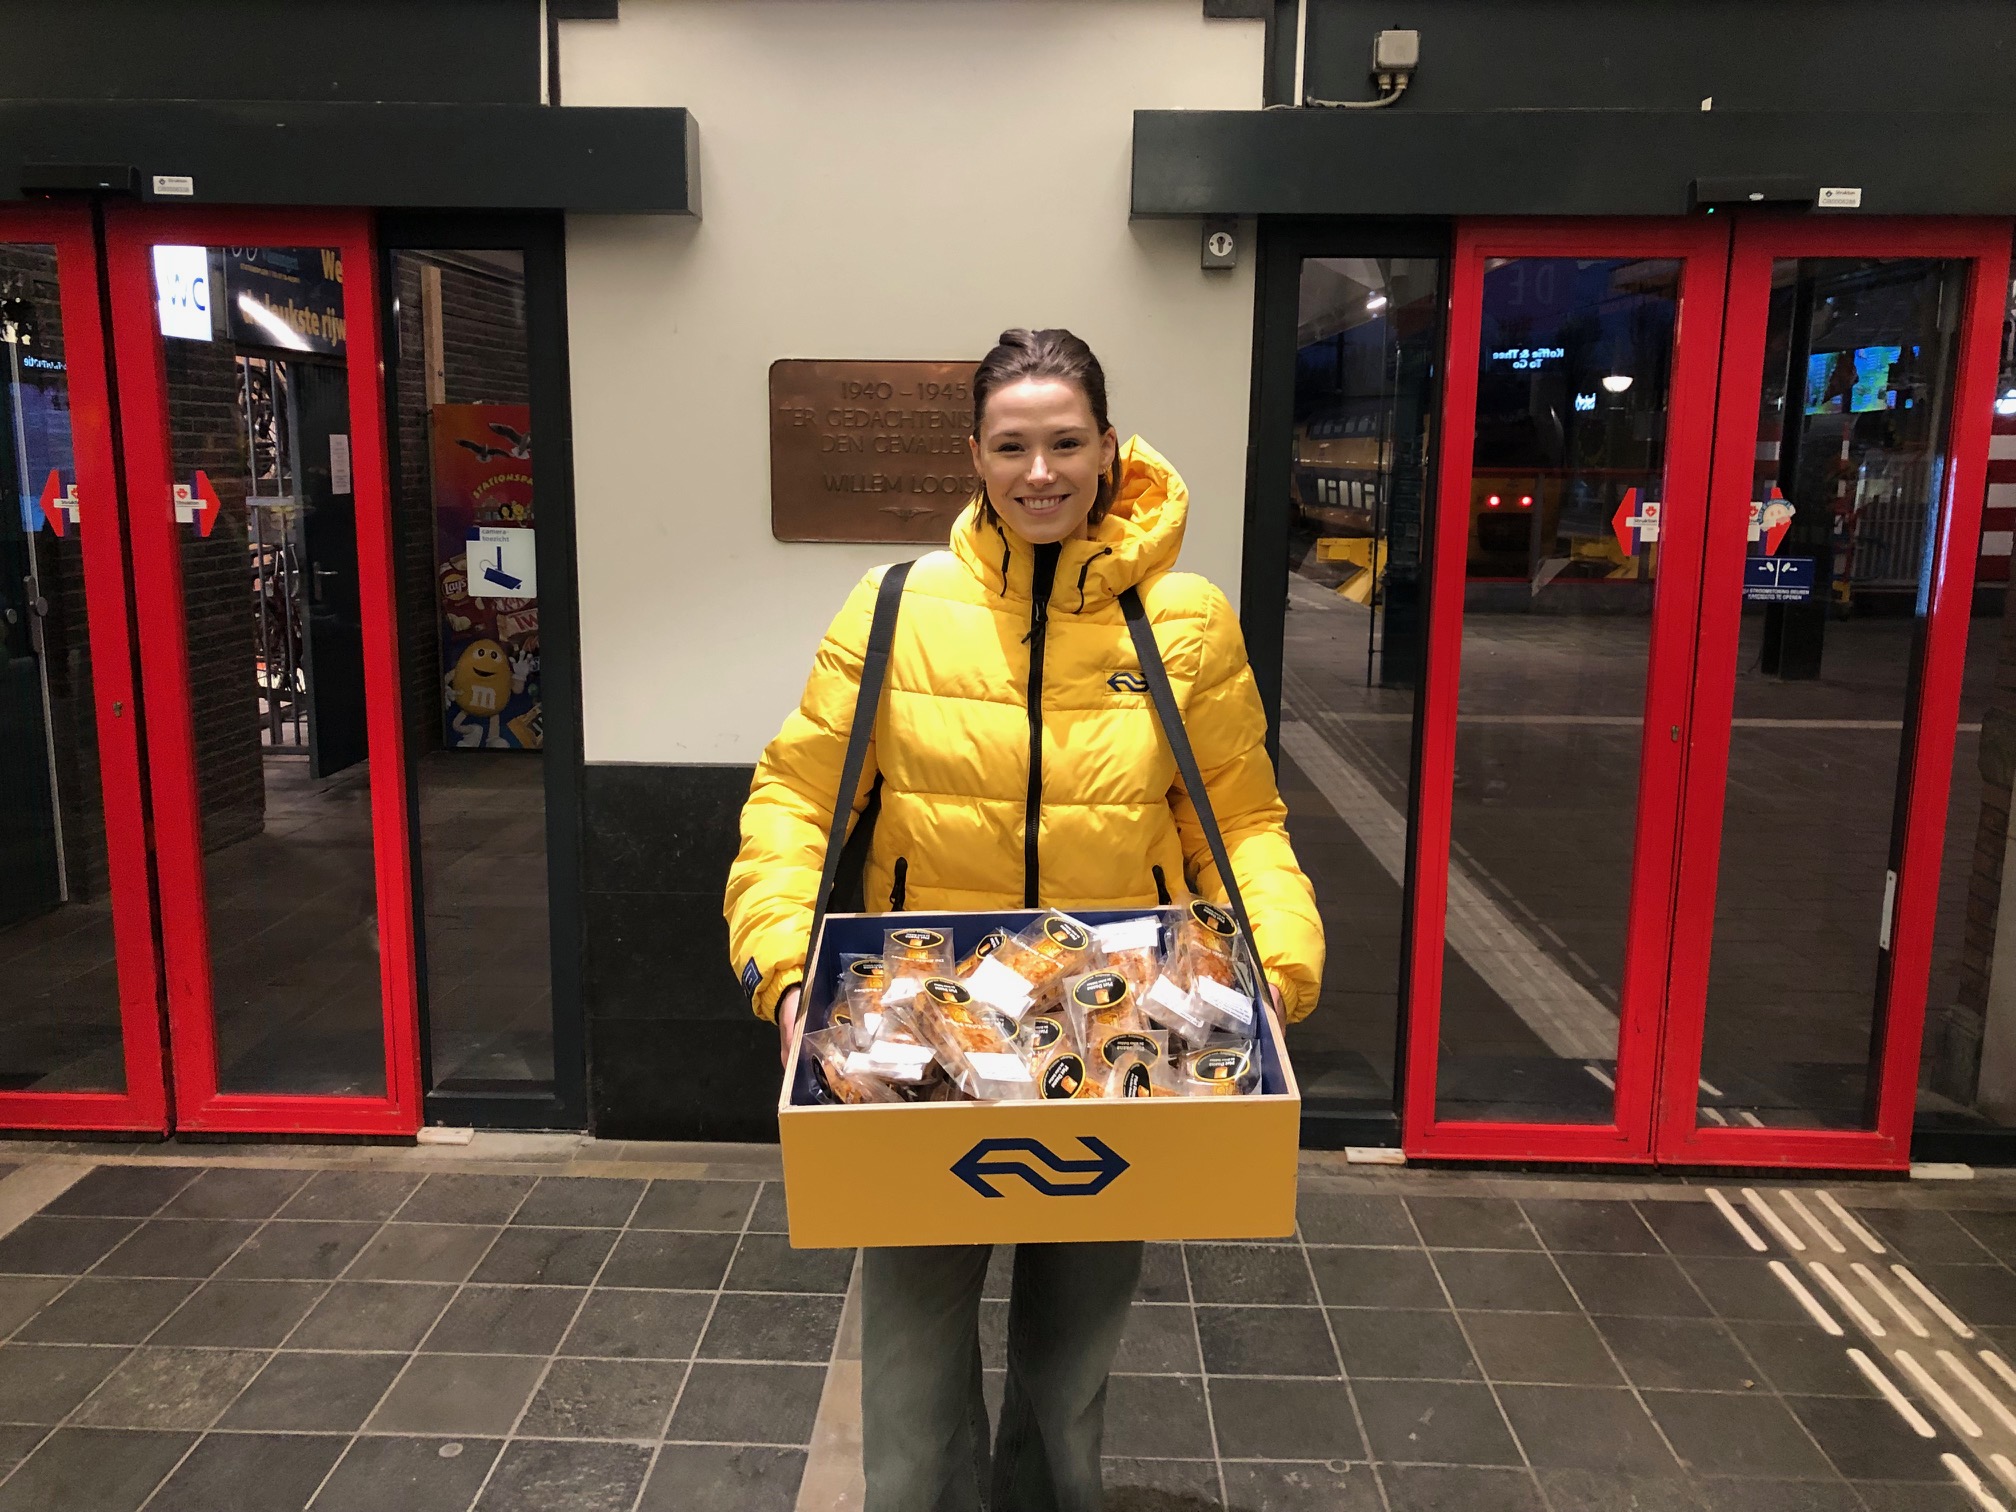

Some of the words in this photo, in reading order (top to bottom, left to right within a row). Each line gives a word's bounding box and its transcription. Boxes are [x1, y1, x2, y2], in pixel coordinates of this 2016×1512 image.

[841, 381, 893, 401] 1940
[917, 381, 968, 401] 1945
[827, 407, 974, 429] GEDACHTENIS
[821, 433, 864, 454] DEN
[823, 472, 903, 493] WILLEM
